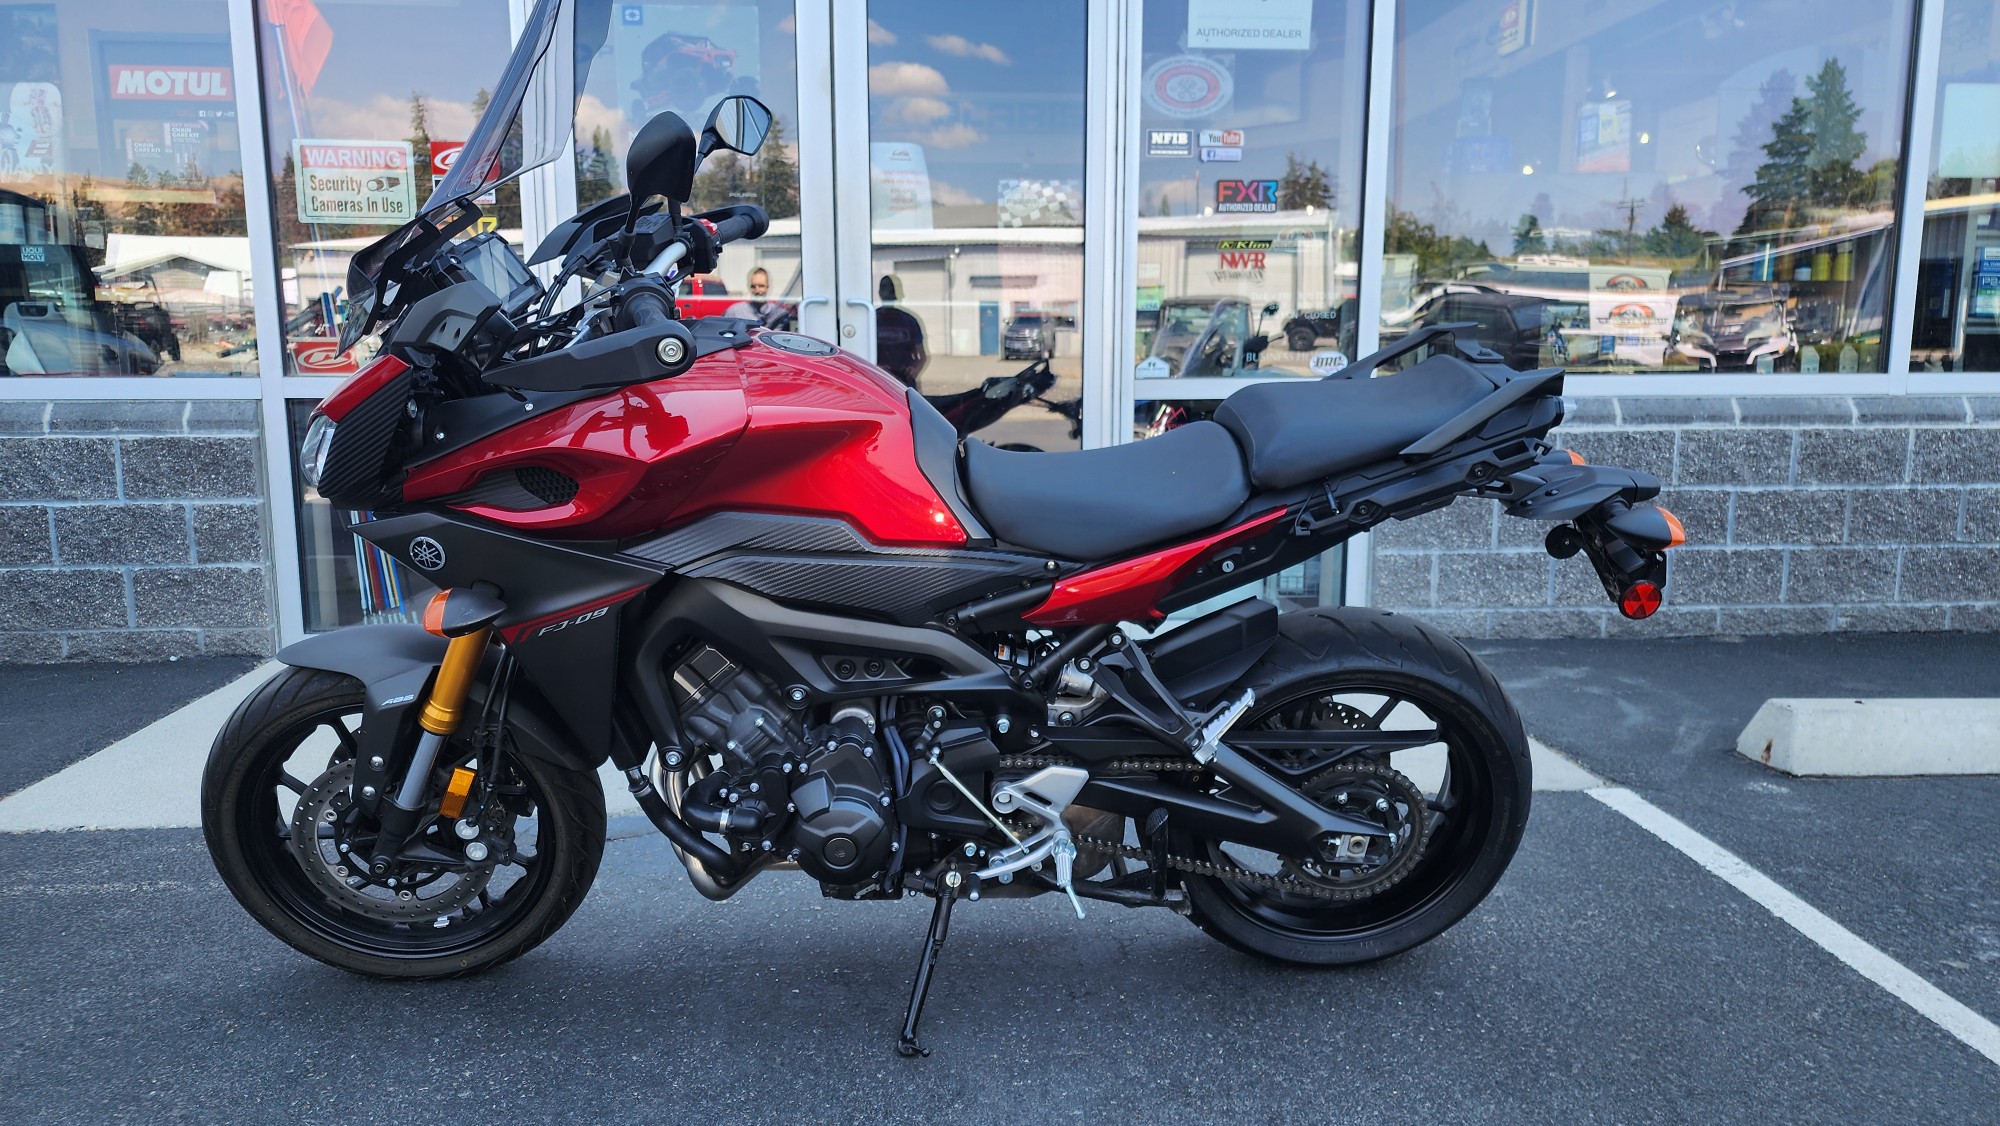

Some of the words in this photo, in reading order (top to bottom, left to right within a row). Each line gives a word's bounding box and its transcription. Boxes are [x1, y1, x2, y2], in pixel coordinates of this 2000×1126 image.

[1196, 28, 1260, 38] AUTHORIZED
[1262, 29, 1302, 39] DEALER
[116, 70, 228, 96] MOTUL
[1151, 132, 1189, 145] NFIB
[305, 148, 401, 167] WARNING
[310, 174, 362, 195] Security
[1218, 181, 1278, 202] FXR
[311, 195, 363, 212] Cameras
[367, 197, 378, 212] In
[382, 197, 403, 213] Use
[1218, 203, 1253, 212] AUTHORIZED
[1253, 203, 1277, 212] DEALER
[1236, 240, 1270, 249] Klim
[1246, 353, 1296, 362] BUSINESS
[538, 606, 609, 637] FJ-09
[381, 694, 415, 706] ABS
